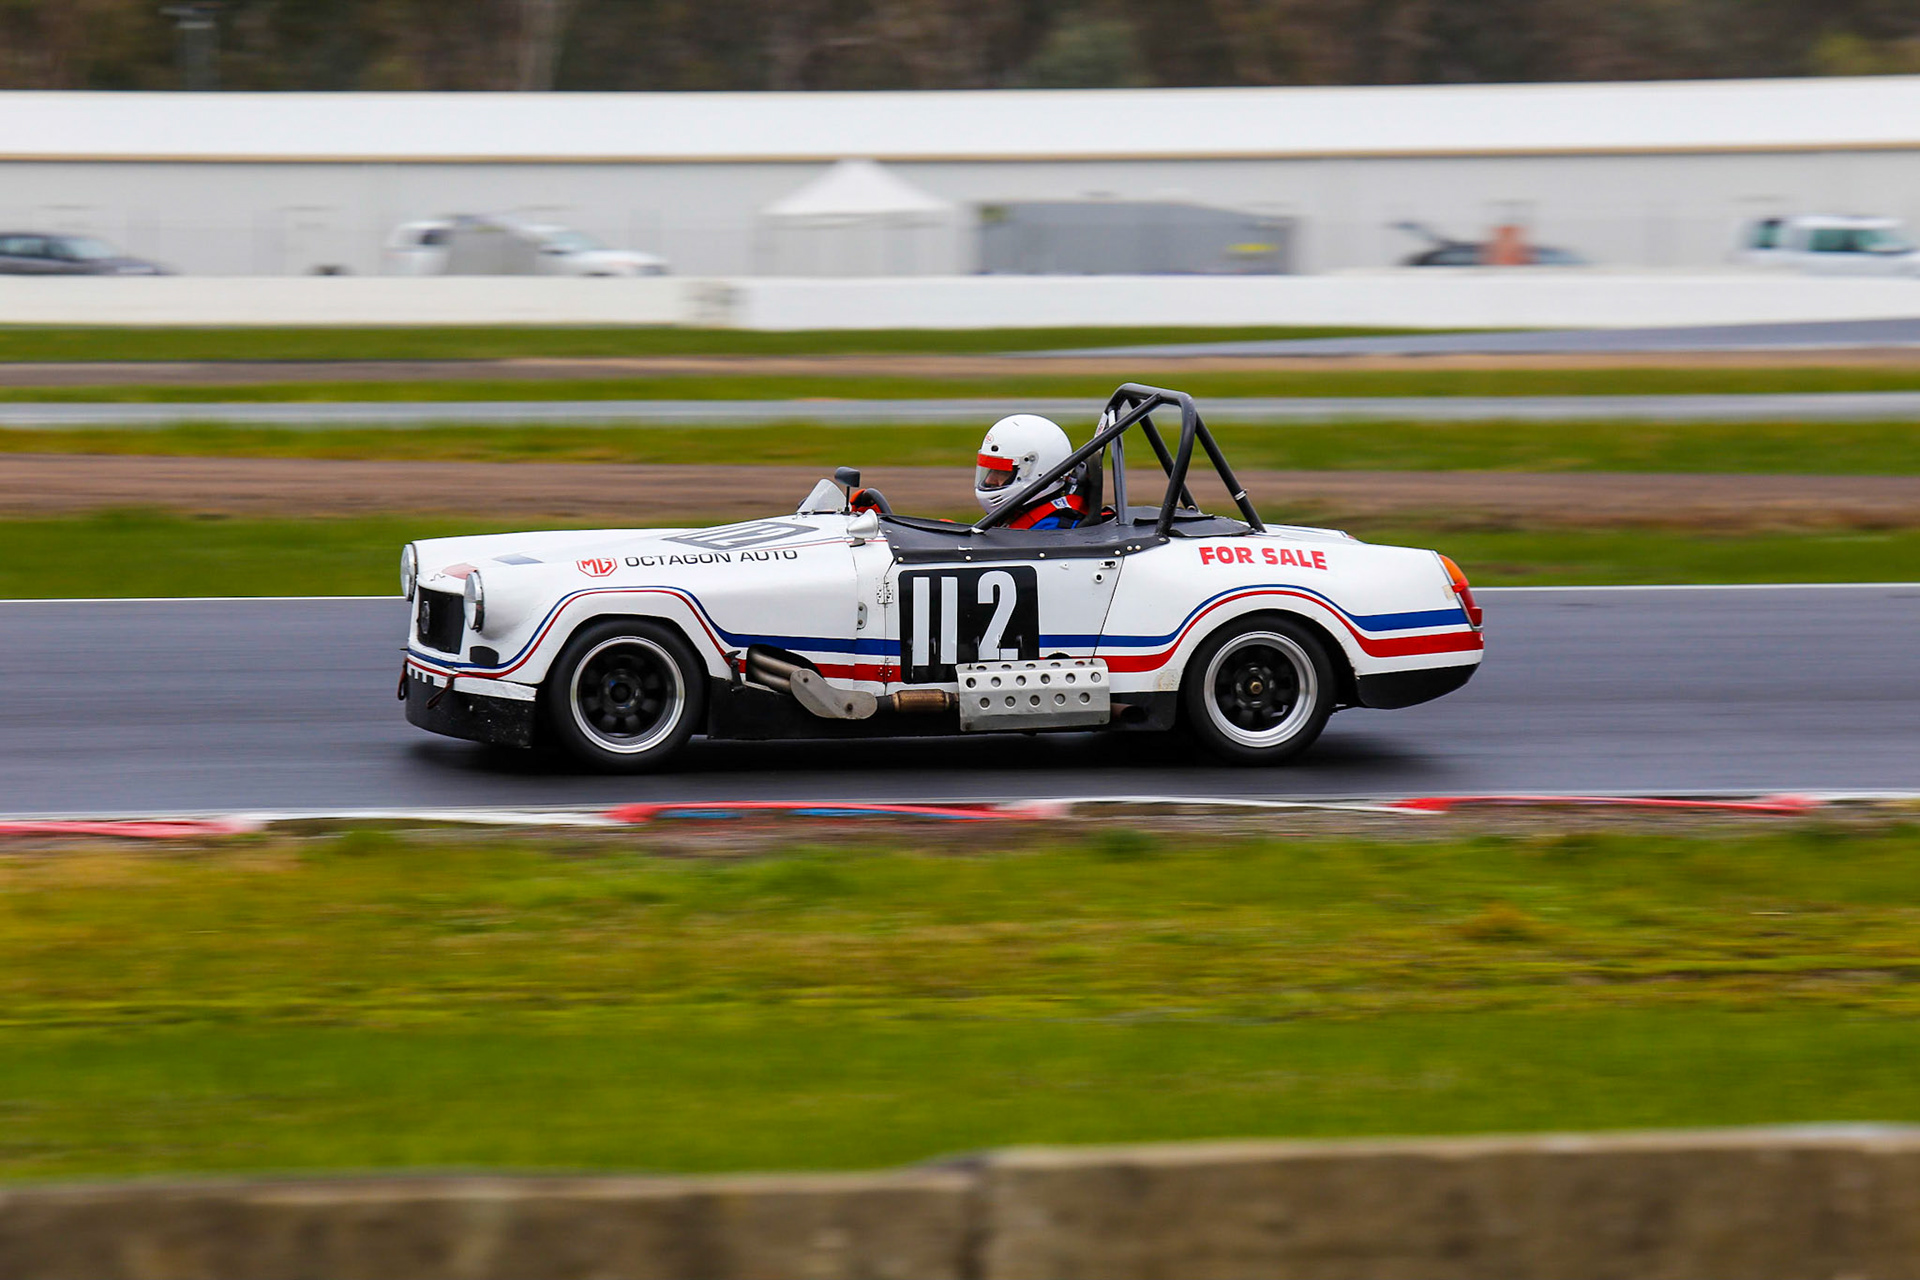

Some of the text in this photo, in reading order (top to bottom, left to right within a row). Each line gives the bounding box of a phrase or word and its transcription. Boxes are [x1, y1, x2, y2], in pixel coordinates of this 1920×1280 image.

[580, 557, 616, 575] MG
[624, 550, 798, 567] OCTAGON AUTO
[1198, 546, 1328, 571] FOR SALE
[911, 570, 1018, 666] 112
